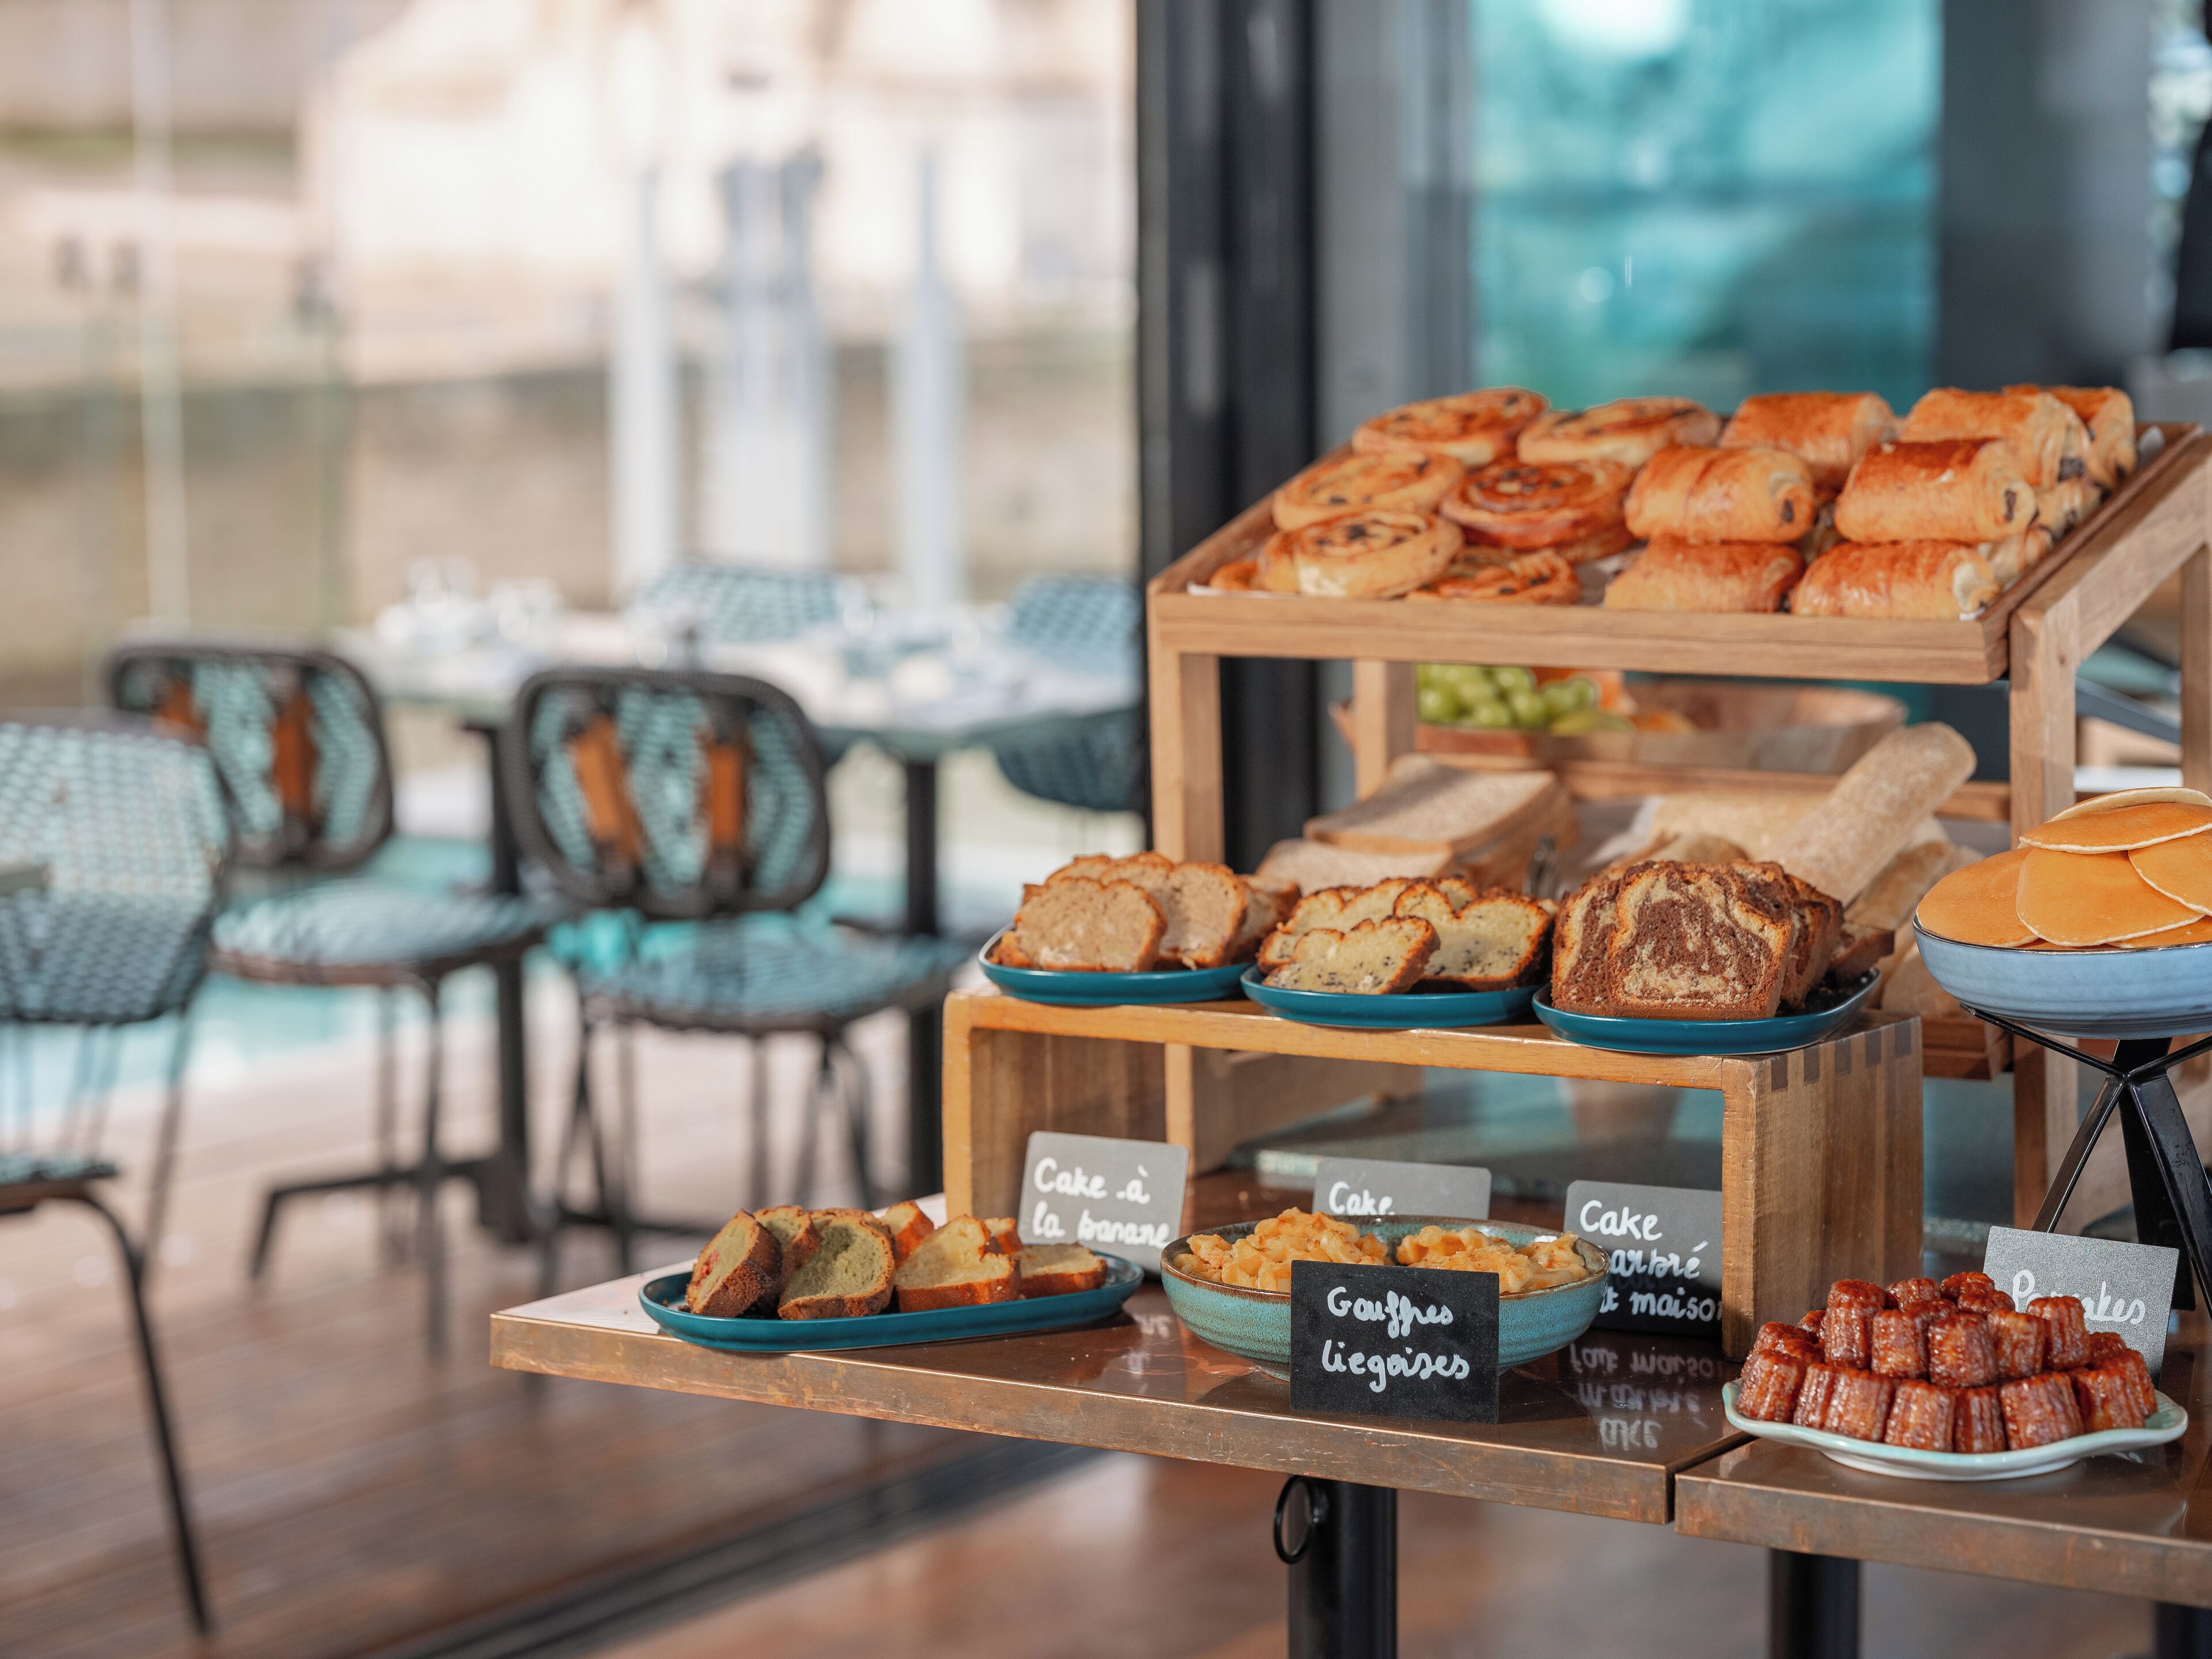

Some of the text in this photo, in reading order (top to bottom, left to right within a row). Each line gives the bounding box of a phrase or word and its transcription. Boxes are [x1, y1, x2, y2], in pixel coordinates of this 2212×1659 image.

[1034, 1157, 1150, 1204] Cake à
[1328, 1181, 1395, 1215] Cake
[1032, 1200, 1172, 1249] la banane
[1580, 1200, 1663, 1241] Cake
[1597, 1240, 1709, 1279] arbré
[2012, 1270, 2146, 1324] Pakes
